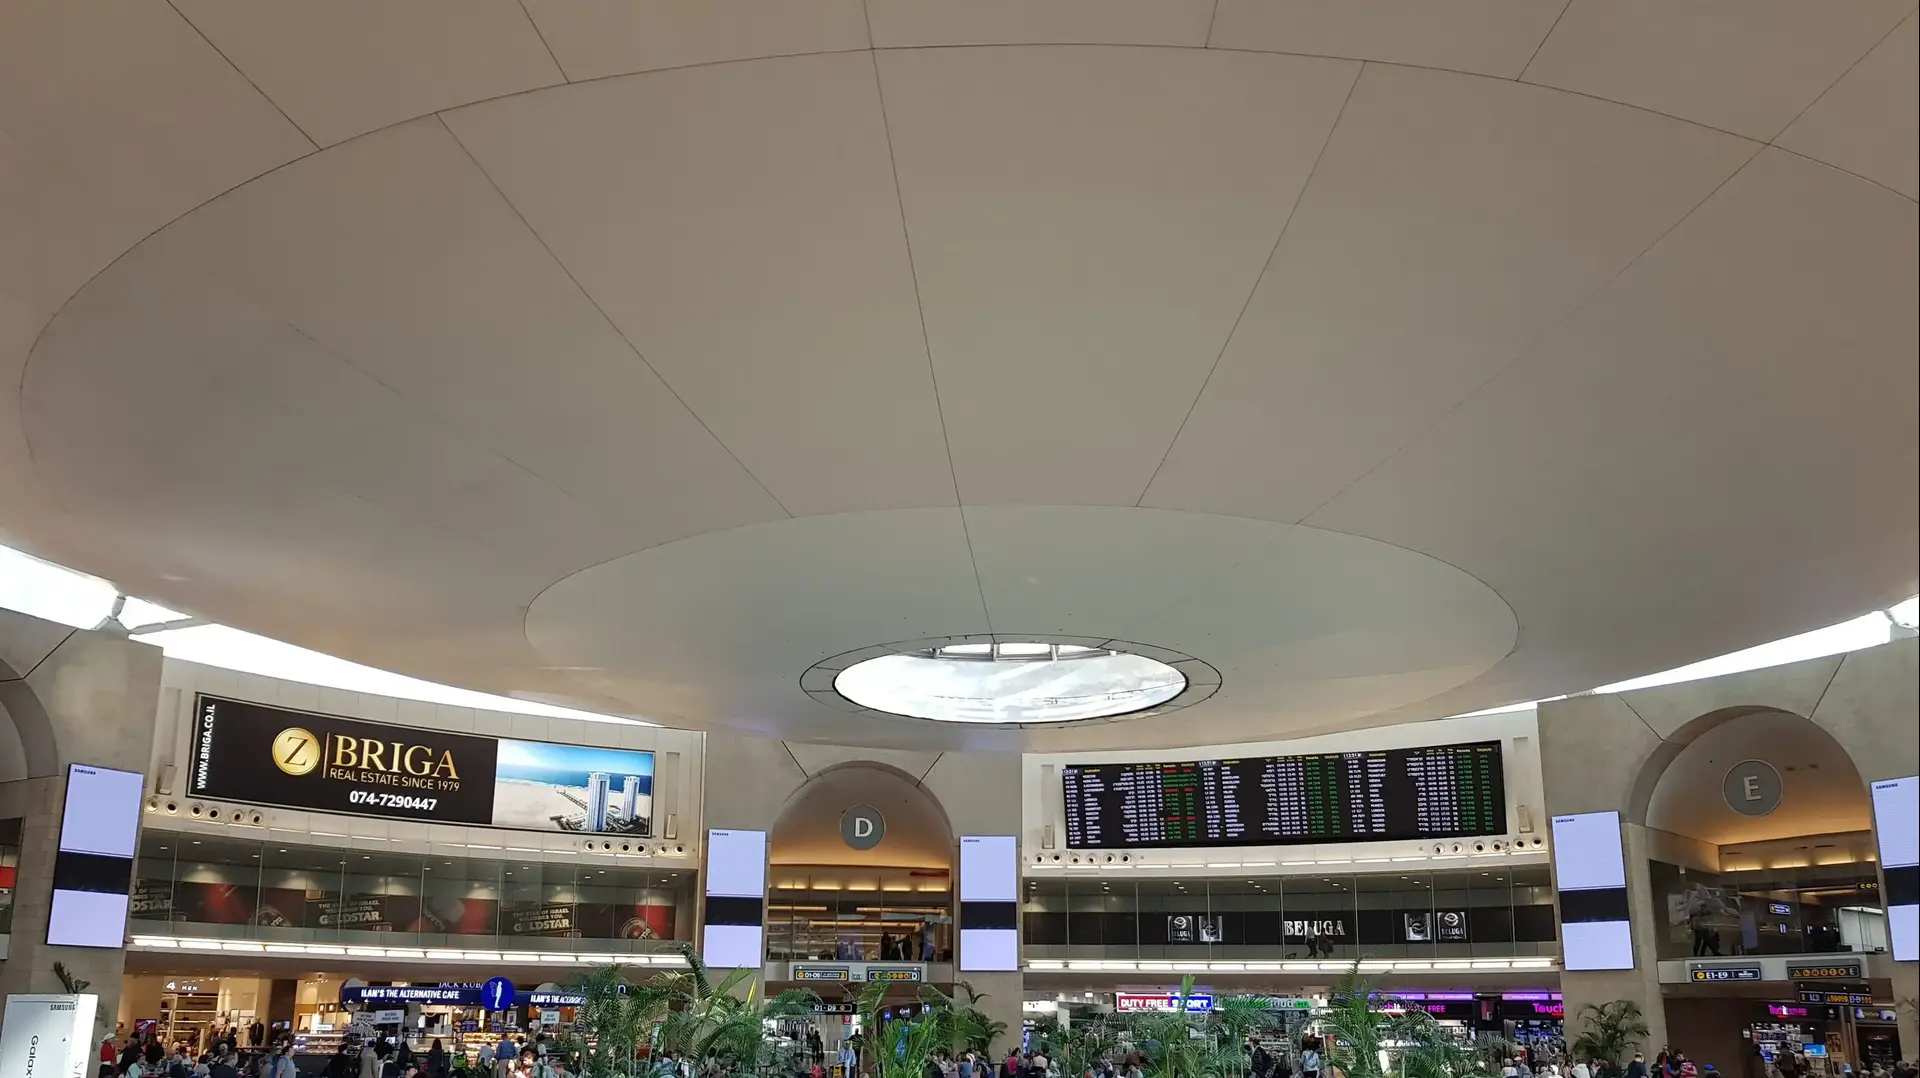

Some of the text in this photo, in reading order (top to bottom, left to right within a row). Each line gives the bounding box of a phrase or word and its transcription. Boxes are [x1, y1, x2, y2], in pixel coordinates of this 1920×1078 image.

[197, 704, 215, 789] WWW.BRIGA.CO.IL
[284, 736, 309, 766] Z
[332, 734, 460, 780] BRIGA
[330, 768, 460, 792] REAL ESTATE SINCE 1979
[1742, 775, 1762, 801] E
[349, 790, 438, 811] 074-7290447
[854, 817, 873, 838] D
[1284, 920, 1345, 936] BELUGA
[1706, 971, 1728, 979] E1-E9
[361, 989, 460, 999] ILAN'S THE ALTERNATIVE CAFE
[1121, 999, 1144, 1008] DUTY
[1145, 999, 1168, 1008] FREE
[26, 1035, 39, 1078] Galax
